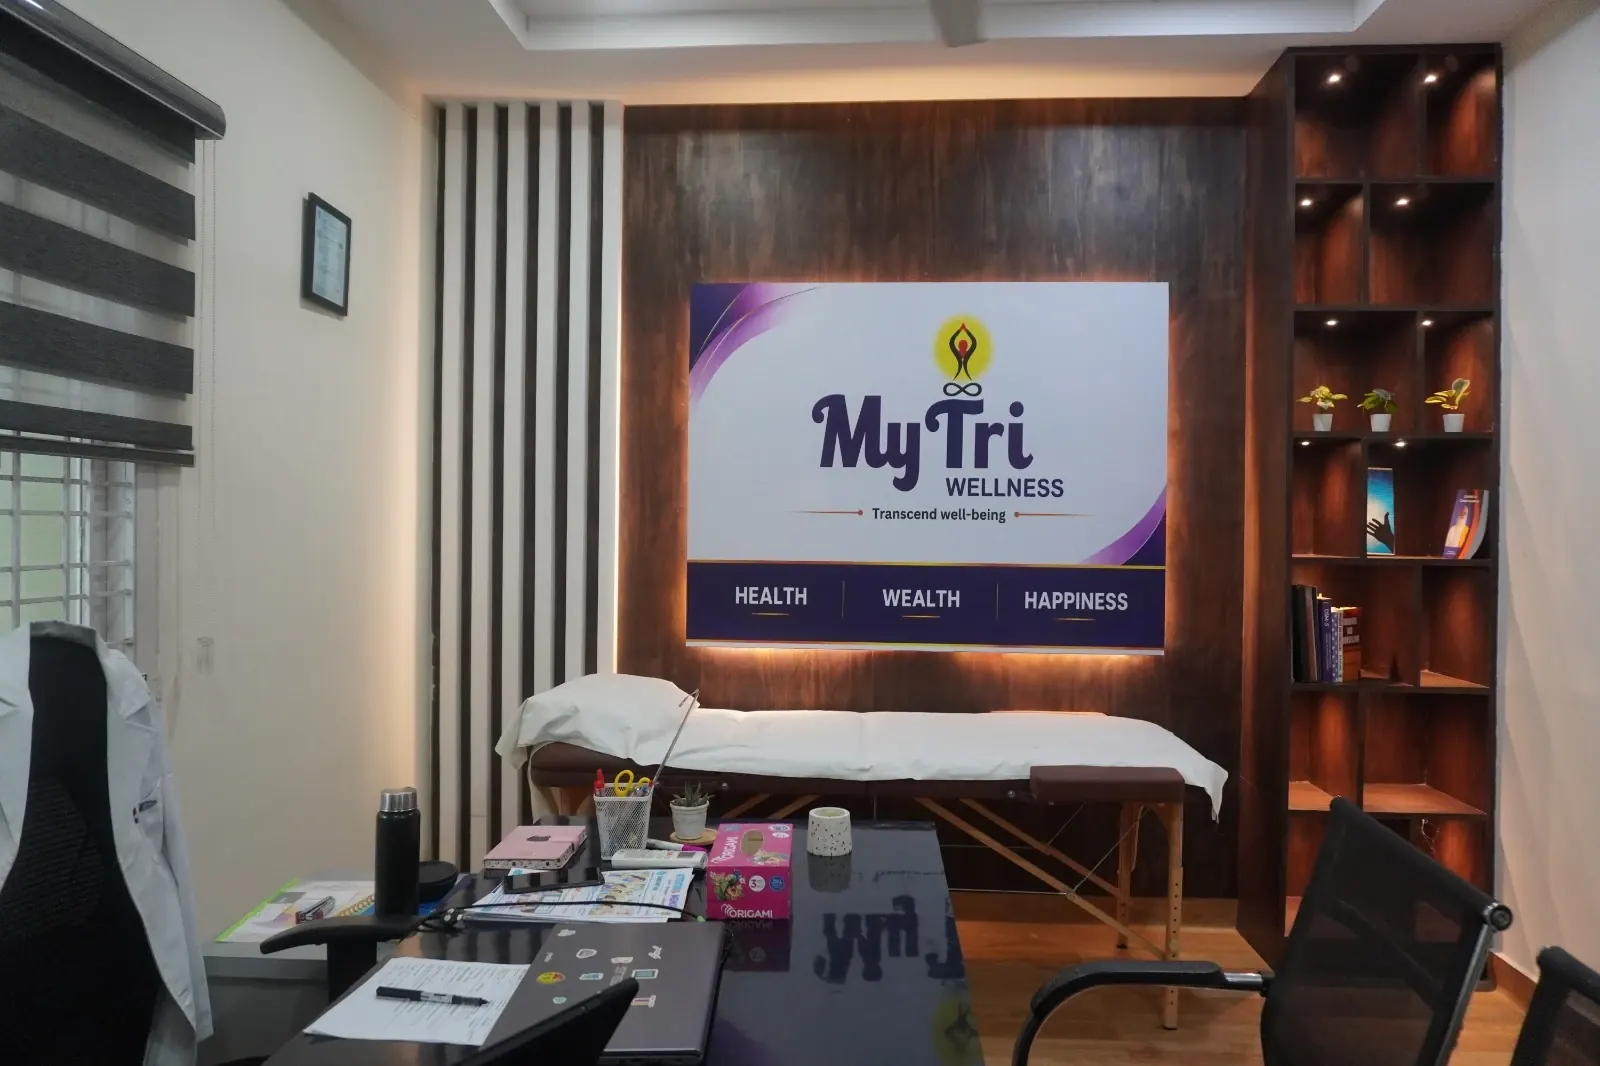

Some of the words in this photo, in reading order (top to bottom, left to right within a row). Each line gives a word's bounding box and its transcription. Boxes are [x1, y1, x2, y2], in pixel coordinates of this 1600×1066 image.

[945, 477, 1065, 498] WELLNESS
[871, 507, 938, 520] Transcend
[940, 508, 1007, 524] well-being
[735, 586, 808, 605] HEALTH
[882, 588, 961, 608] WEALTH
[1024, 591, 1129, 611] HAPPINESS
[729, 909, 773, 918] ORIGAMI
